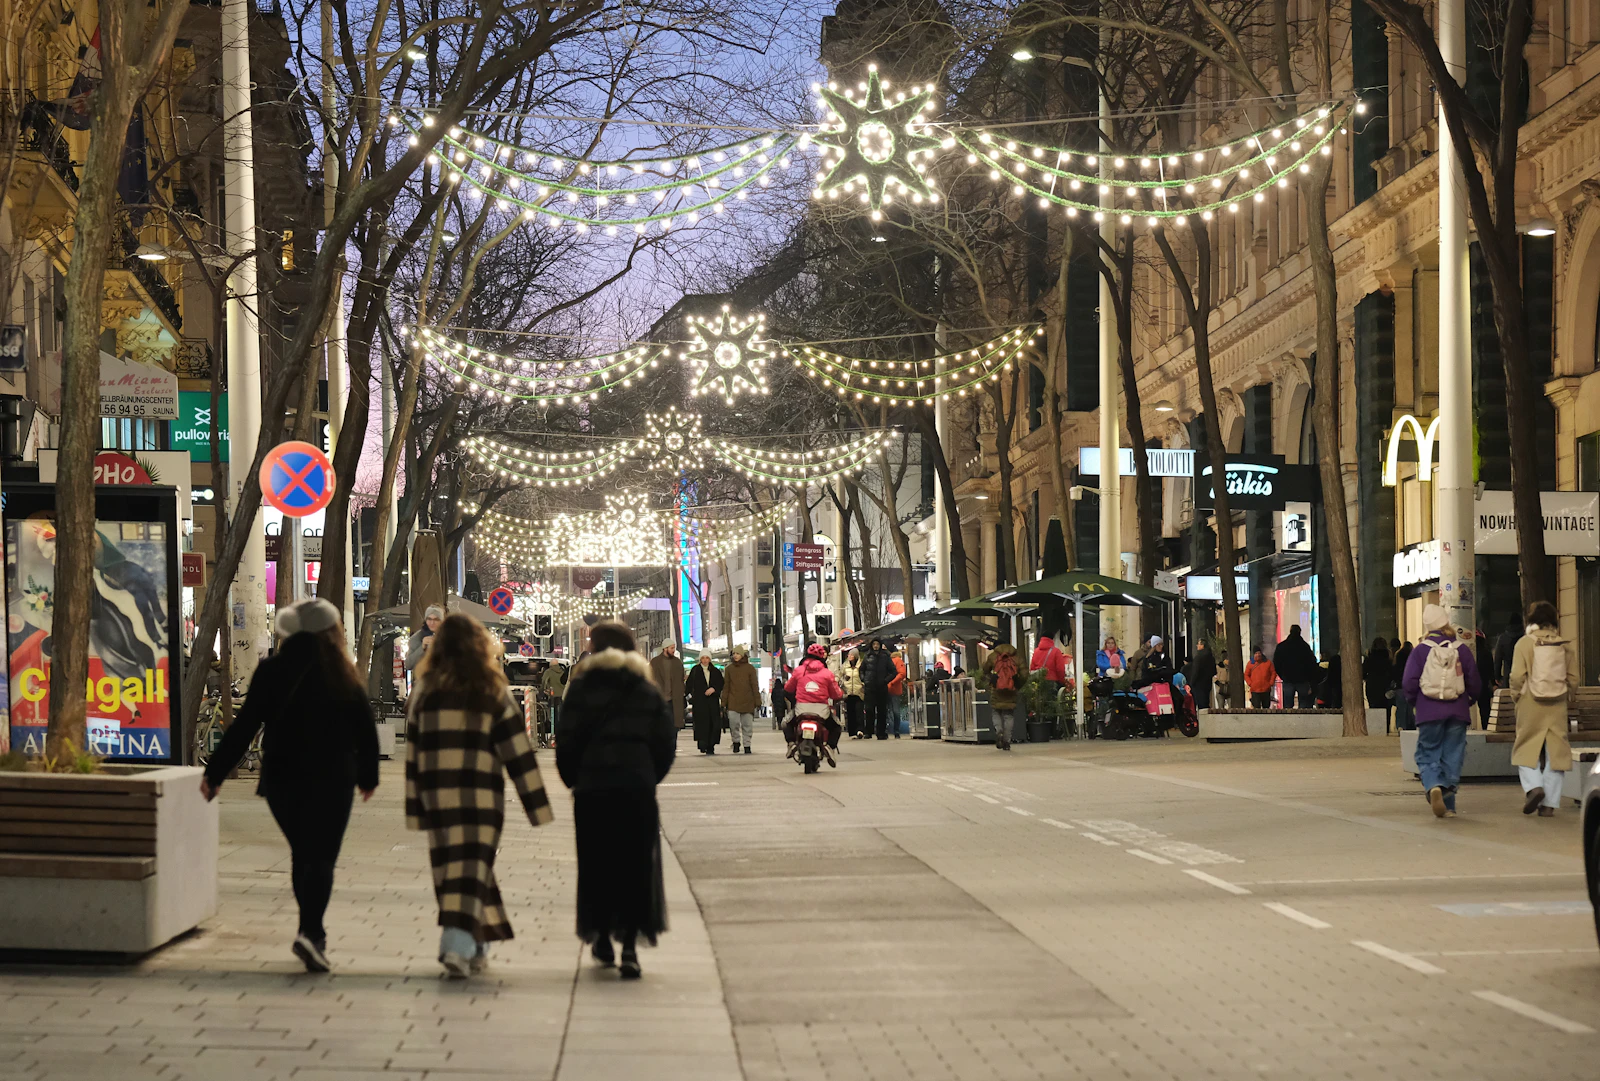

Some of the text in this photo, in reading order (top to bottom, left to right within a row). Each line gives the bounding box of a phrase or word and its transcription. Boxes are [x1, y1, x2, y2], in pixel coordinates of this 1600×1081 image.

[117, 373, 169, 387] Miami
[118, 405, 131, 414] 94
[133, 405, 146, 415] 95
[152, 407, 175, 415] SAUNA
[175, 429, 230, 442] pullovria
[1129, 451, 1190, 474] BTOLOTTI
[1479, 515, 1595, 531] NOWH VINTAGE
[795, 546, 822, 555] Gerngross
[795, 561, 822, 569] Stiftgasse
[19, 667, 165, 713] Cgall
[23, 732, 165, 756] ALRTINA
